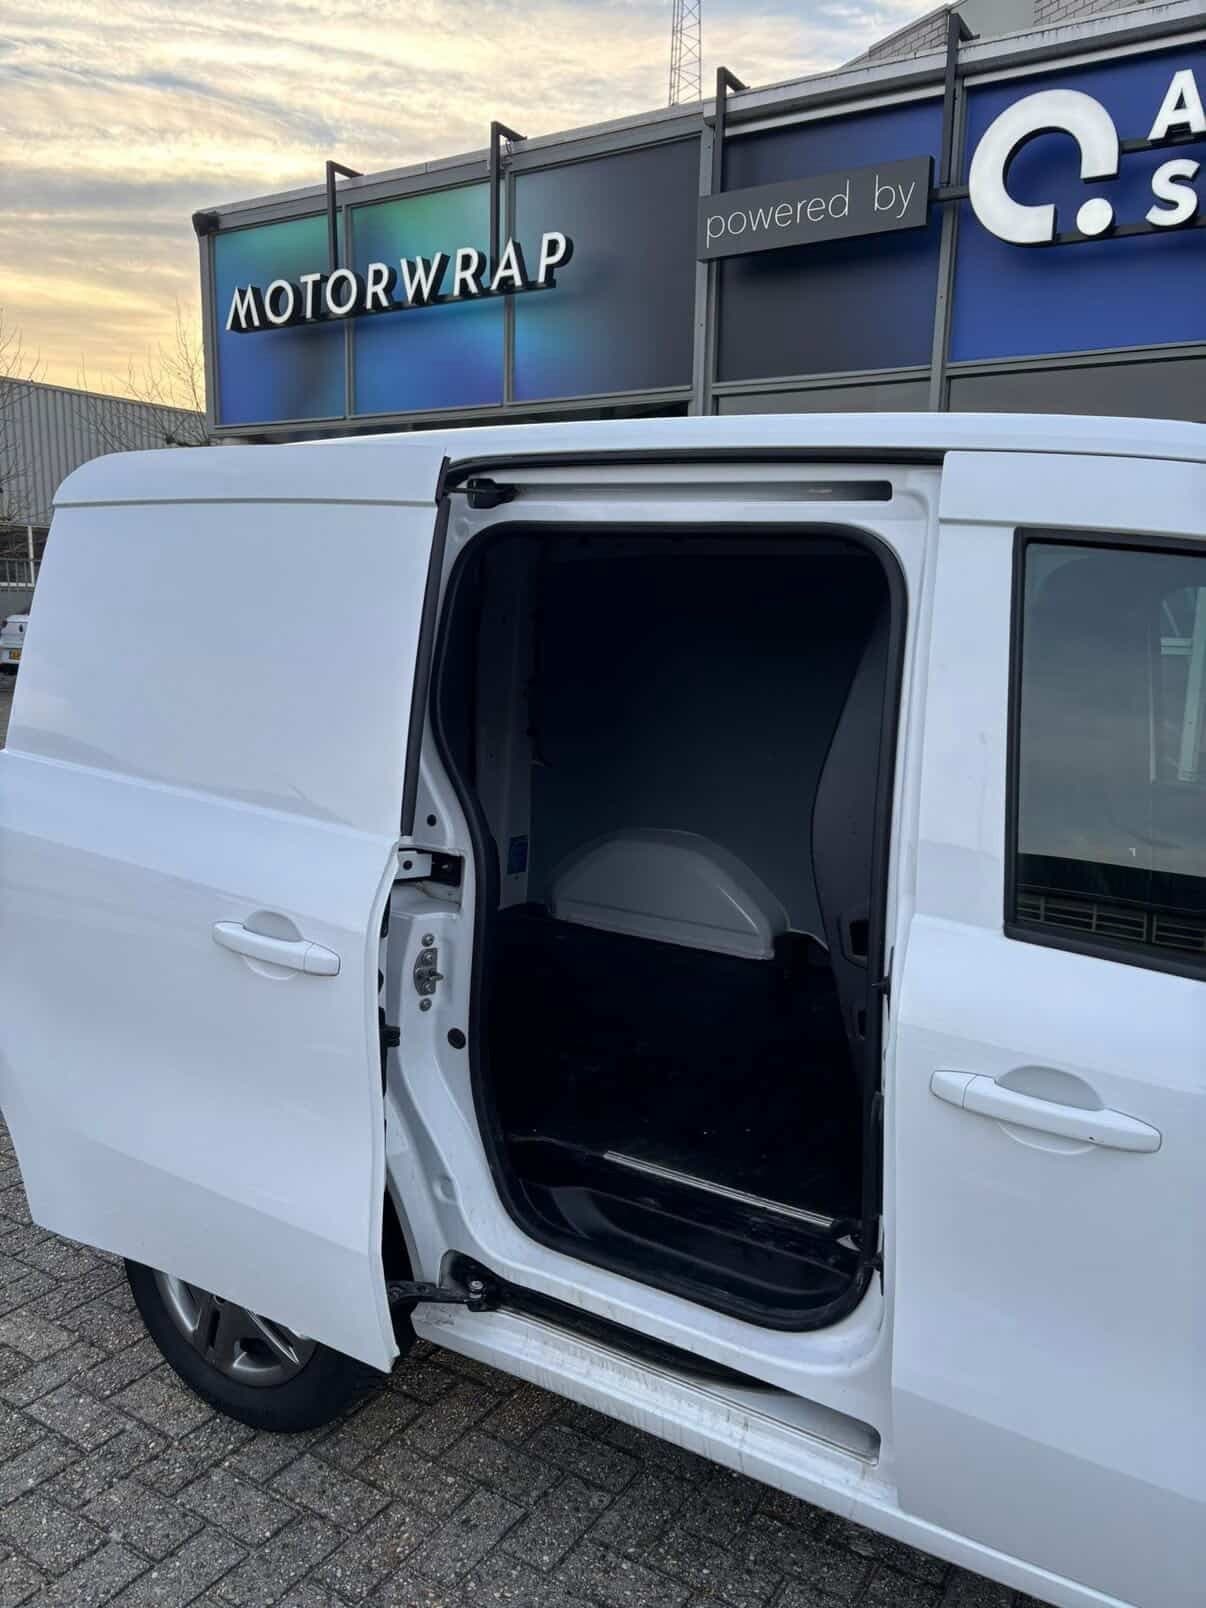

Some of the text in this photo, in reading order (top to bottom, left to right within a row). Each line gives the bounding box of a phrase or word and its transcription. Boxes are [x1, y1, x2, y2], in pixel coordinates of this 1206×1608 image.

[705, 174, 916, 248] powered by
[225, 231, 569, 330] MOTORWRAP
